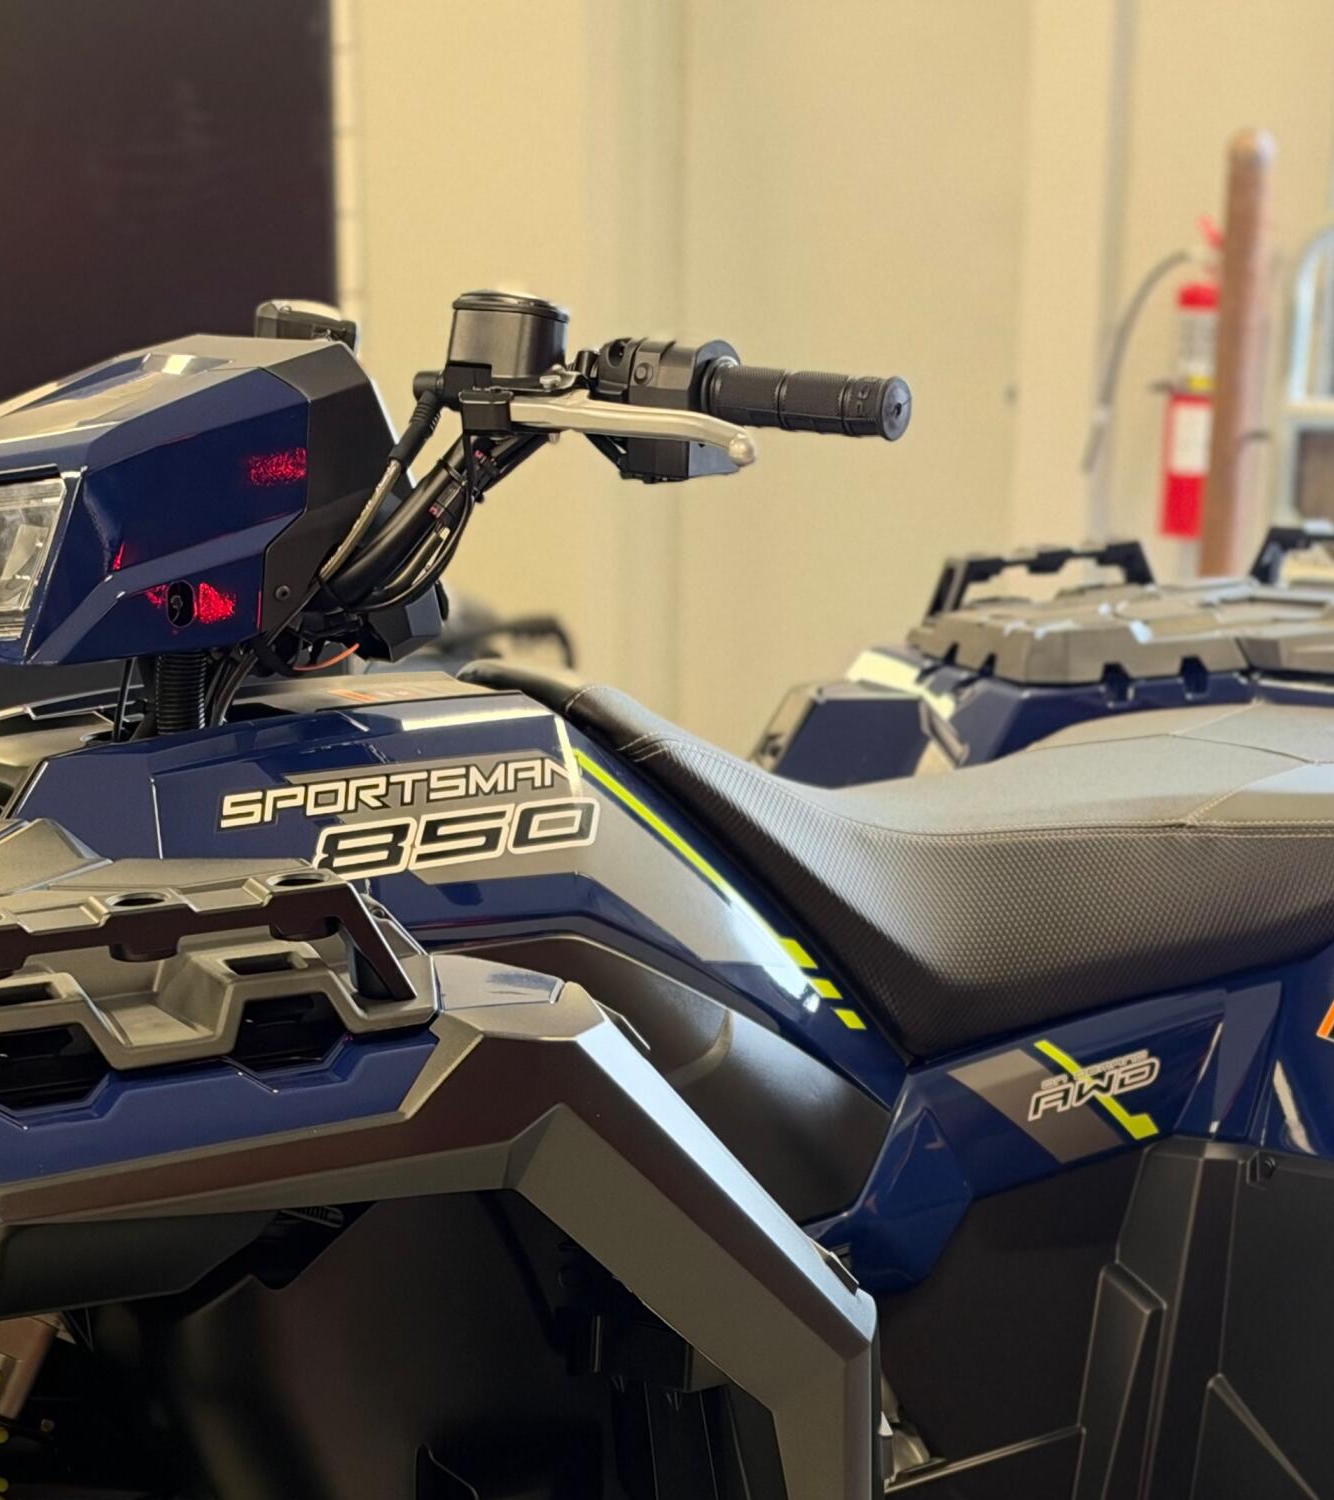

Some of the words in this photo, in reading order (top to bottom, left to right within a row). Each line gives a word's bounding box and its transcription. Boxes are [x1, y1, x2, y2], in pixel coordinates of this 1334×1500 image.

[220, 757, 581, 829] SPORTSMAN
[313, 796, 601, 881] 850
[1028, 1057, 1161, 1122] AWD
